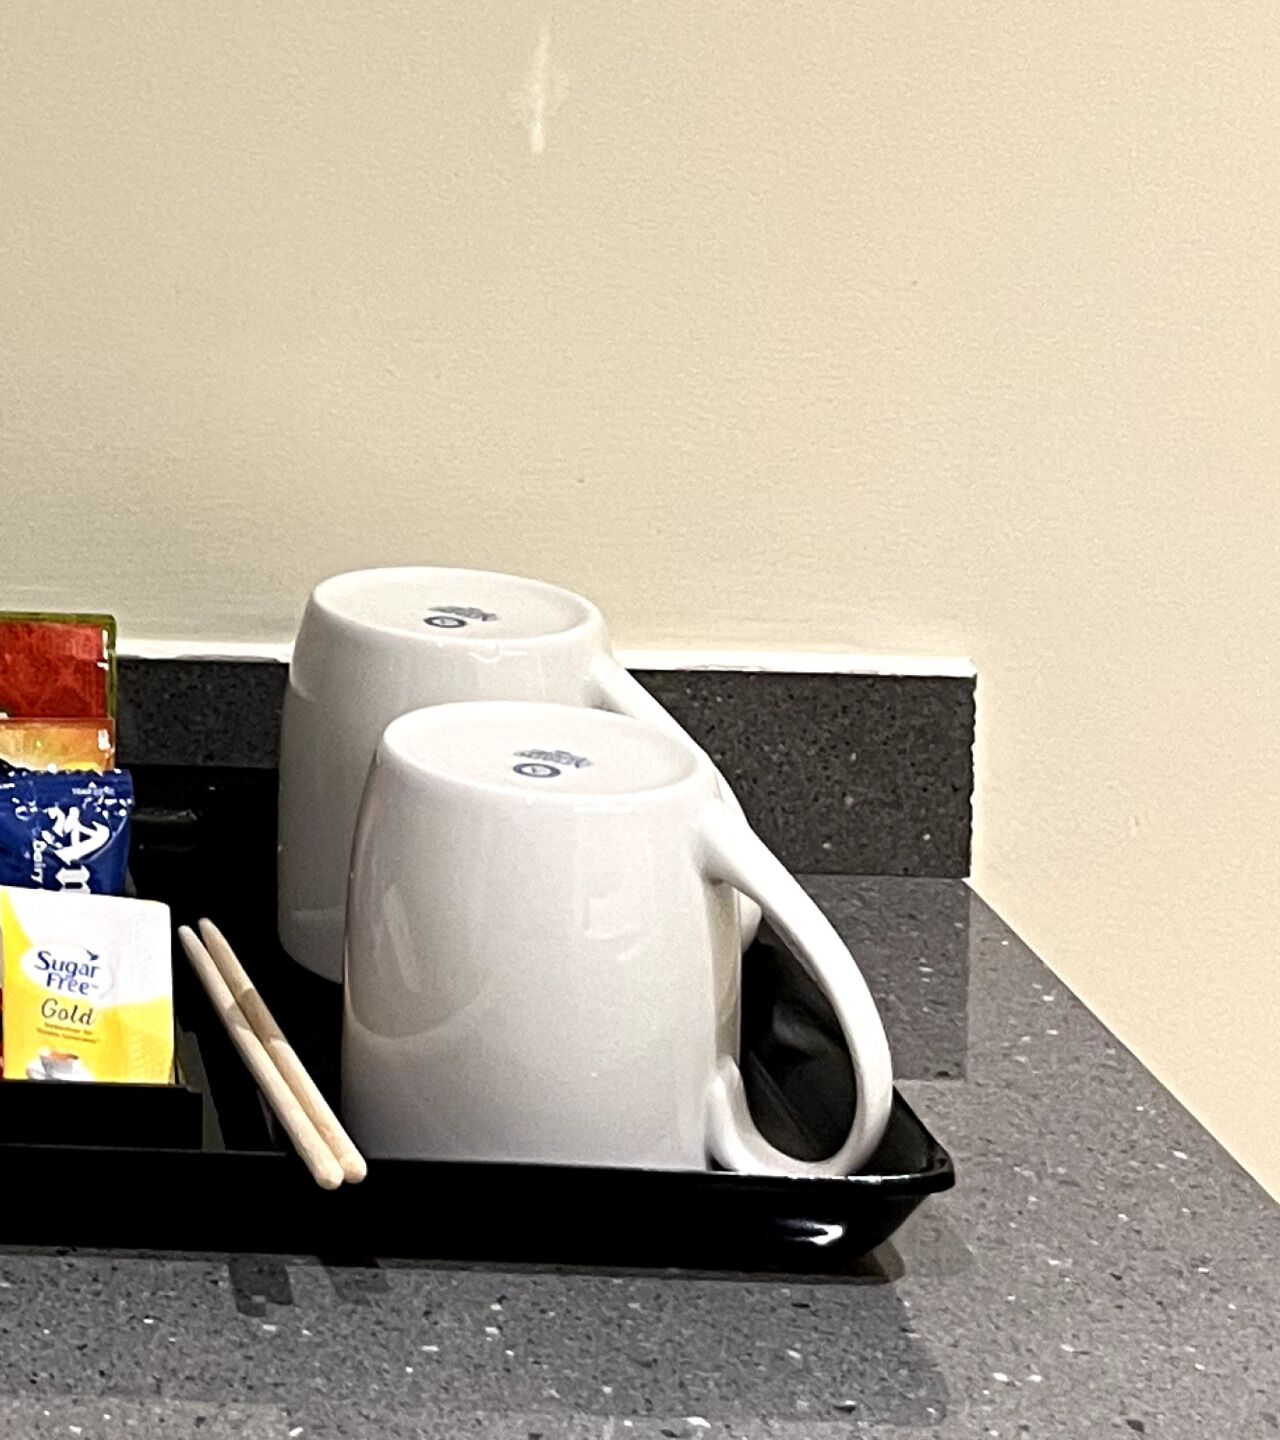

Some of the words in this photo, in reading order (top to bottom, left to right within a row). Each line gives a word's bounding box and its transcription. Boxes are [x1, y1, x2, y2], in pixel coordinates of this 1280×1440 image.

[34, 950, 100, 979] Sugar
[46, 971, 90, 996] Free
[41, 998, 94, 1027] Gold
